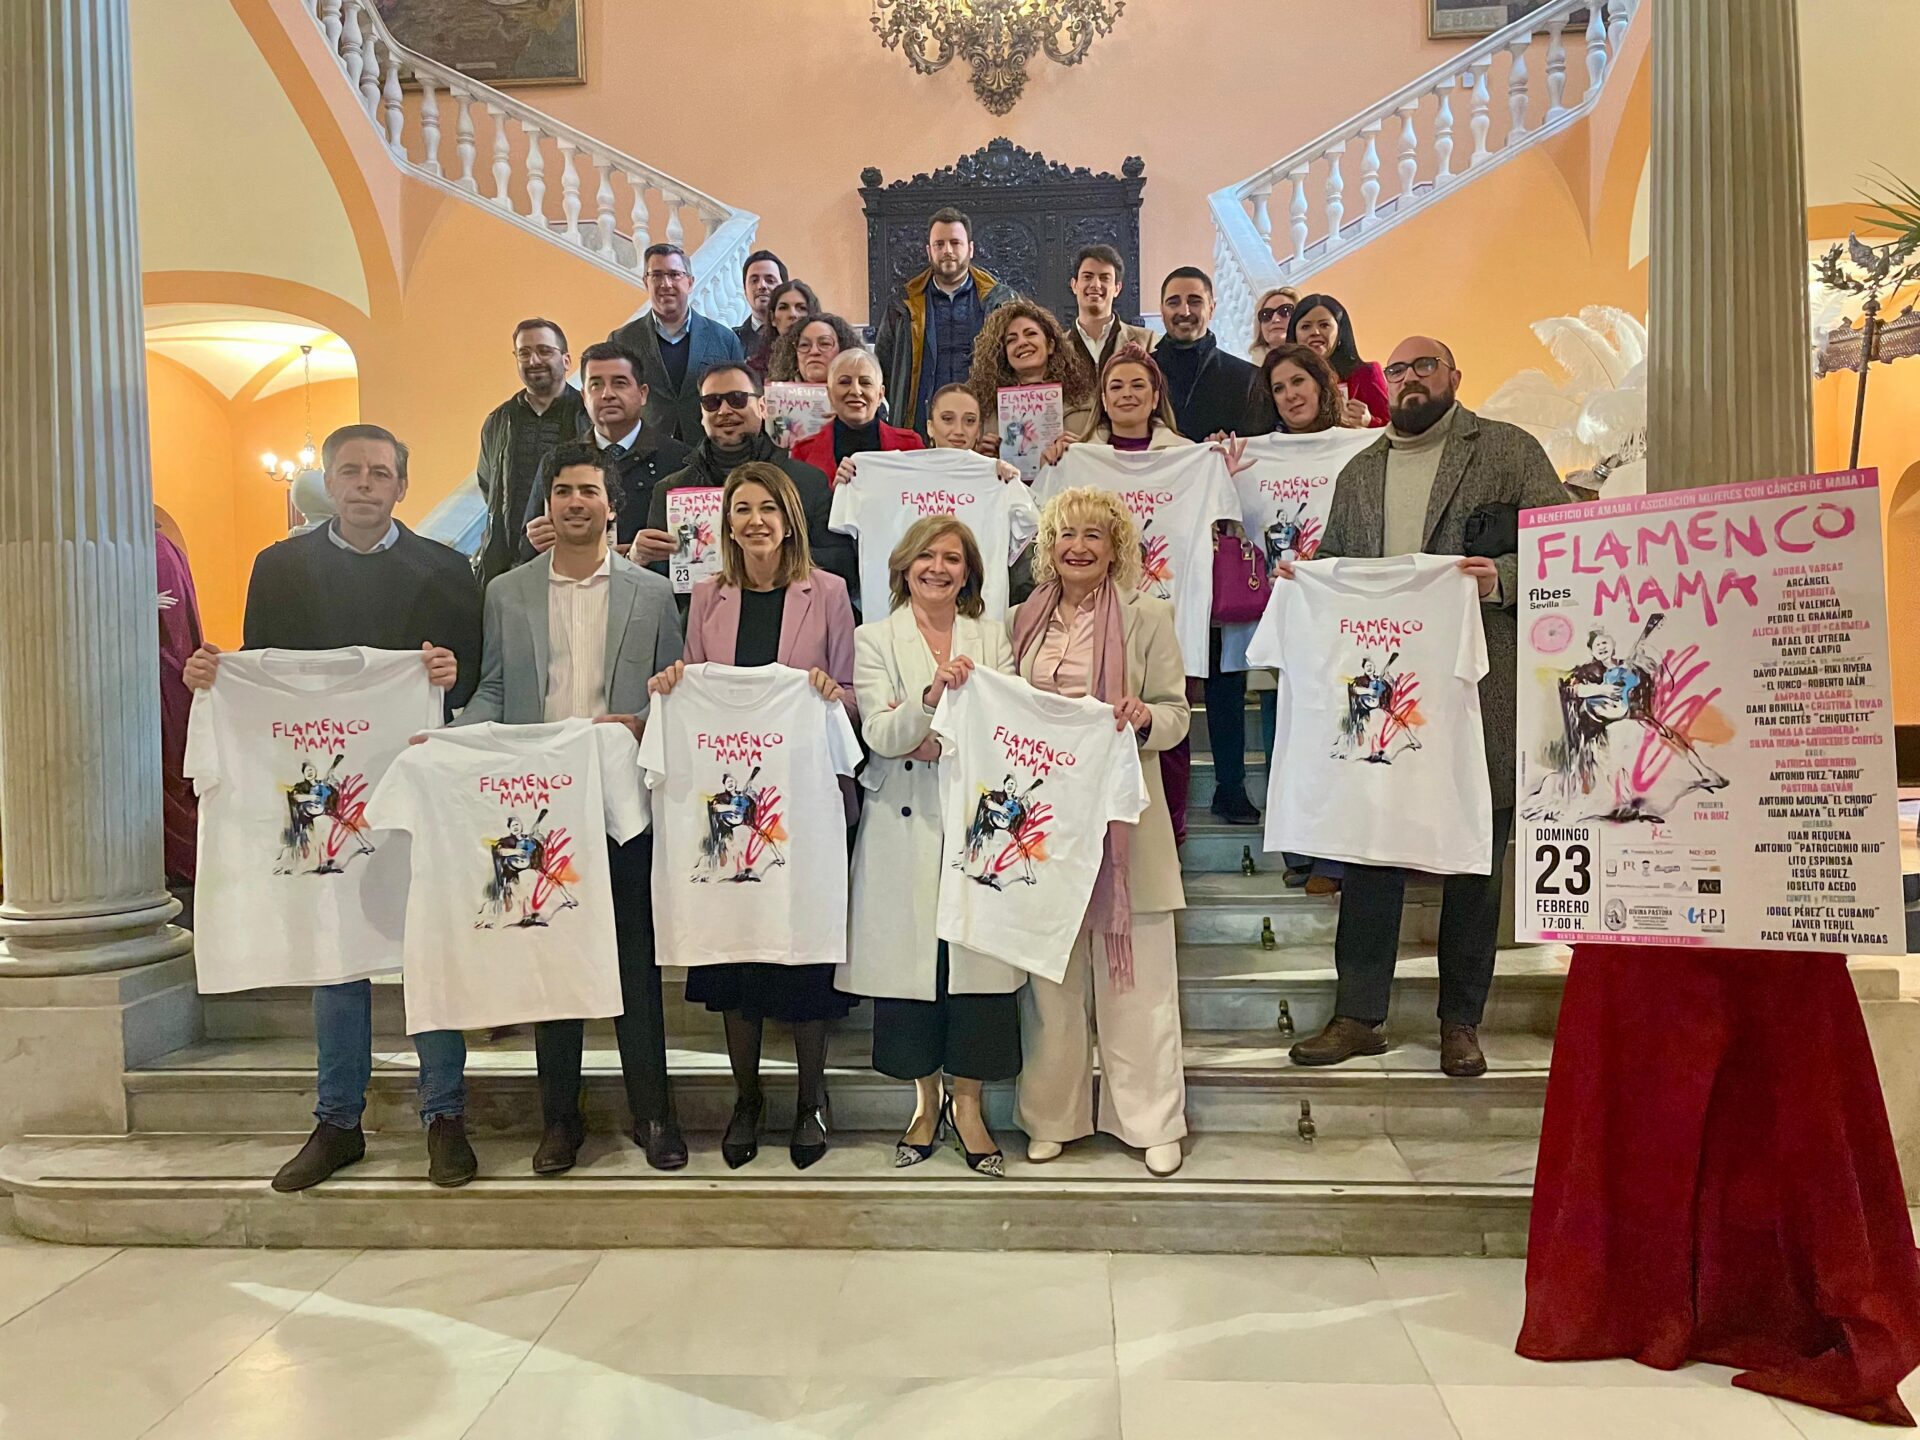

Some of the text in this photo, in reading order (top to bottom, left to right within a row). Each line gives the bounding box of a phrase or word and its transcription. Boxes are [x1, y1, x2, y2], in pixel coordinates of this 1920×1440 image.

[1001, 390, 1059, 405] FLAMENCO
[1260, 476, 1328, 492] FLAMENCO
[901, 490, 975, 505] FLAMENCO
[1273, 489, 1310, 503] MAMA
[1529, 515, 1536, 525] A
[1537, 509, 1582, 523] BENEFICIO
[1583, 507, 1595, 518] DE
[1598, 502, 1632, 516] AMAMA
[1744, 487, 1765, 499] CON
[1767, 480, 1807, 496] CÁNCER
[1809, 479, 1822, 490] DE
[1825, 475, 1858, 488] MAMA
[684, 504, 720, 517] MAMA
[918, 504, 956, 516] MAMA
[1538, 502, 1855, 580] FLAMENCO
[1808, 562, 1843, 573] VARGAS
[675, 569, 690, 582] 23
[1786, 575, 1830, 587] ARCÁNGEL
[1528, 588, 1571, 601] fibes
[1594, 568, 1758, 627] MAMA
[1530, 601, 1560, 610] Sevilla
[1799, 598, 1841, 610] VALENCIA
[1767, 614, 1794, 624] PEDRO
[1797, 613, 1806, 623] EL
[1340, 617, 1423, 634] FLAMENCO
[1356, 633, 1402, 653] MAMA
[1772, 633, 1851, 646] RAFAEL DE UTRERA
[1782, 644, 1841, 657] DAVID CARPIO
[1753, 663, 1872, 678] DAVID PALOMAR RIKI RIVERA
[1808, 677, 1844, 688] ROBERTO
[1746, 704, 1767, 714] DANI
[1769, 702, 1805, 713] BONILLA
[1754, 716, 1777, 726] FRAN
[1779, 711, 1811, 725] CORTÉS
[272, 718, 370, 738] FLAMENCO
[294, 736, 345, 755] MAMA
[697, 731, 783, 749] FLAMENCO
[993, 726, 1076, 766] FLAMENCO
[716, 748, 762, 767] MAMA
[1006, 748, 1051, 777] MAMA
[480, 773, 572, 792] FLAMENCO
[1769, 771, 1805, 781] ANTONIO
[500, 791, 550, 810] MAMA
[1759, 796, 1794, 806] ANTONIO
[1796, 795, 1829, 805] MOLINA
[1790, 807, 1821, 817] AMAYA
[1536, 828, 1589, 841] DOMINGO
[1811, 831, 1852, 841] REQUENA
[1754, 843, 1792, 853] ANTONIO
[1788, 855, 1853, 866] LITO ESPINOSA
[1535, 844, 1591, 895] 23
[1828, 881, 1857, 891] ACEDO
[1536, 899, 1589, 914] FEBRERO
[1795, 903, 1822, 917] PÉREZ
[1542, 917, 1585, 930] 17:00 H.
[1823, 919, 1855, 930] TERUEL
[1761, 930, 1888, 944] PACO VEGA Y RUBÉN VARGAS
